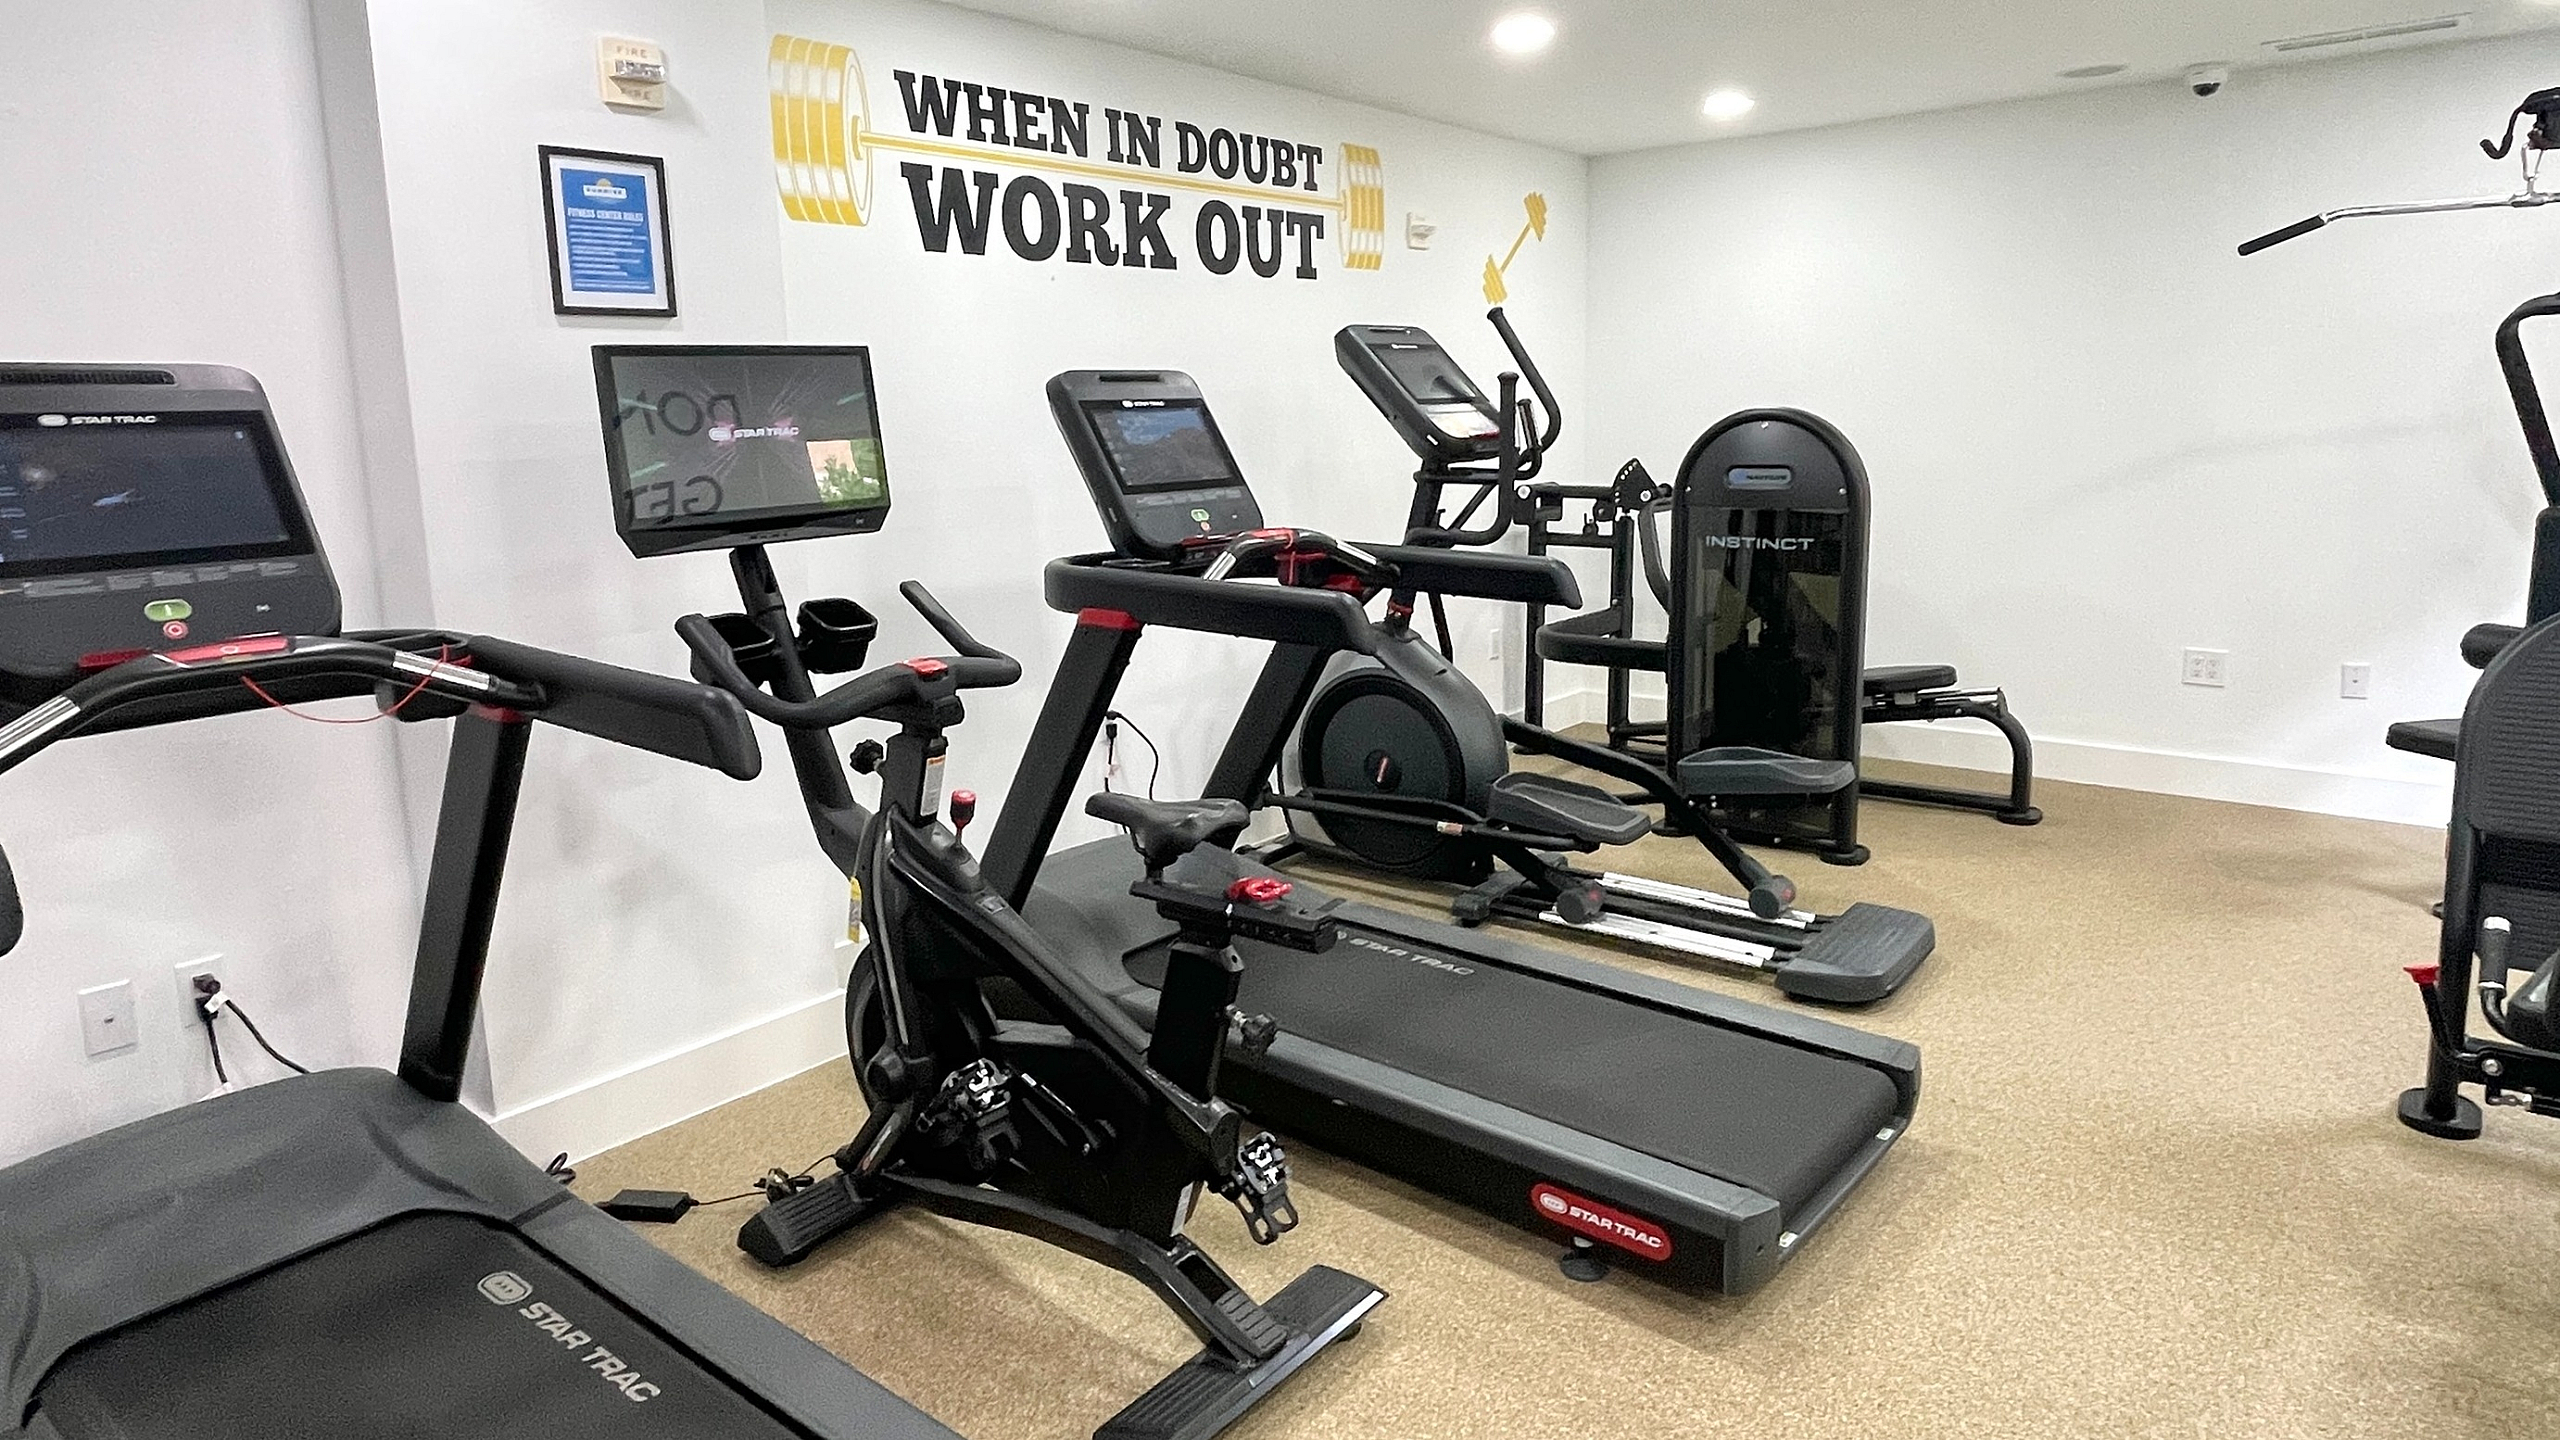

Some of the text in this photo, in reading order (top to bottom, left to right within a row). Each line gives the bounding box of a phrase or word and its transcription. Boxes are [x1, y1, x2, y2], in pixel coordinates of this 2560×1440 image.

[616, 45, 648, 59] FIRE
[893, 70, 1323, 191] WHEN IN DOUBT
[902, 162, 1324, 280] WORK OUT
[70, 415, 158, 425] STAR TRAC
[733, 426, 799, 440] STAR TRAC
[1706, 535, 1815, 551] INSTINCT
[1349, 938, 1475, 976] STAR TRAC
[1569, 1206, 1663, 1248] STAR TRAC
[518, 1301, 661, 1402] STAR TRAC
